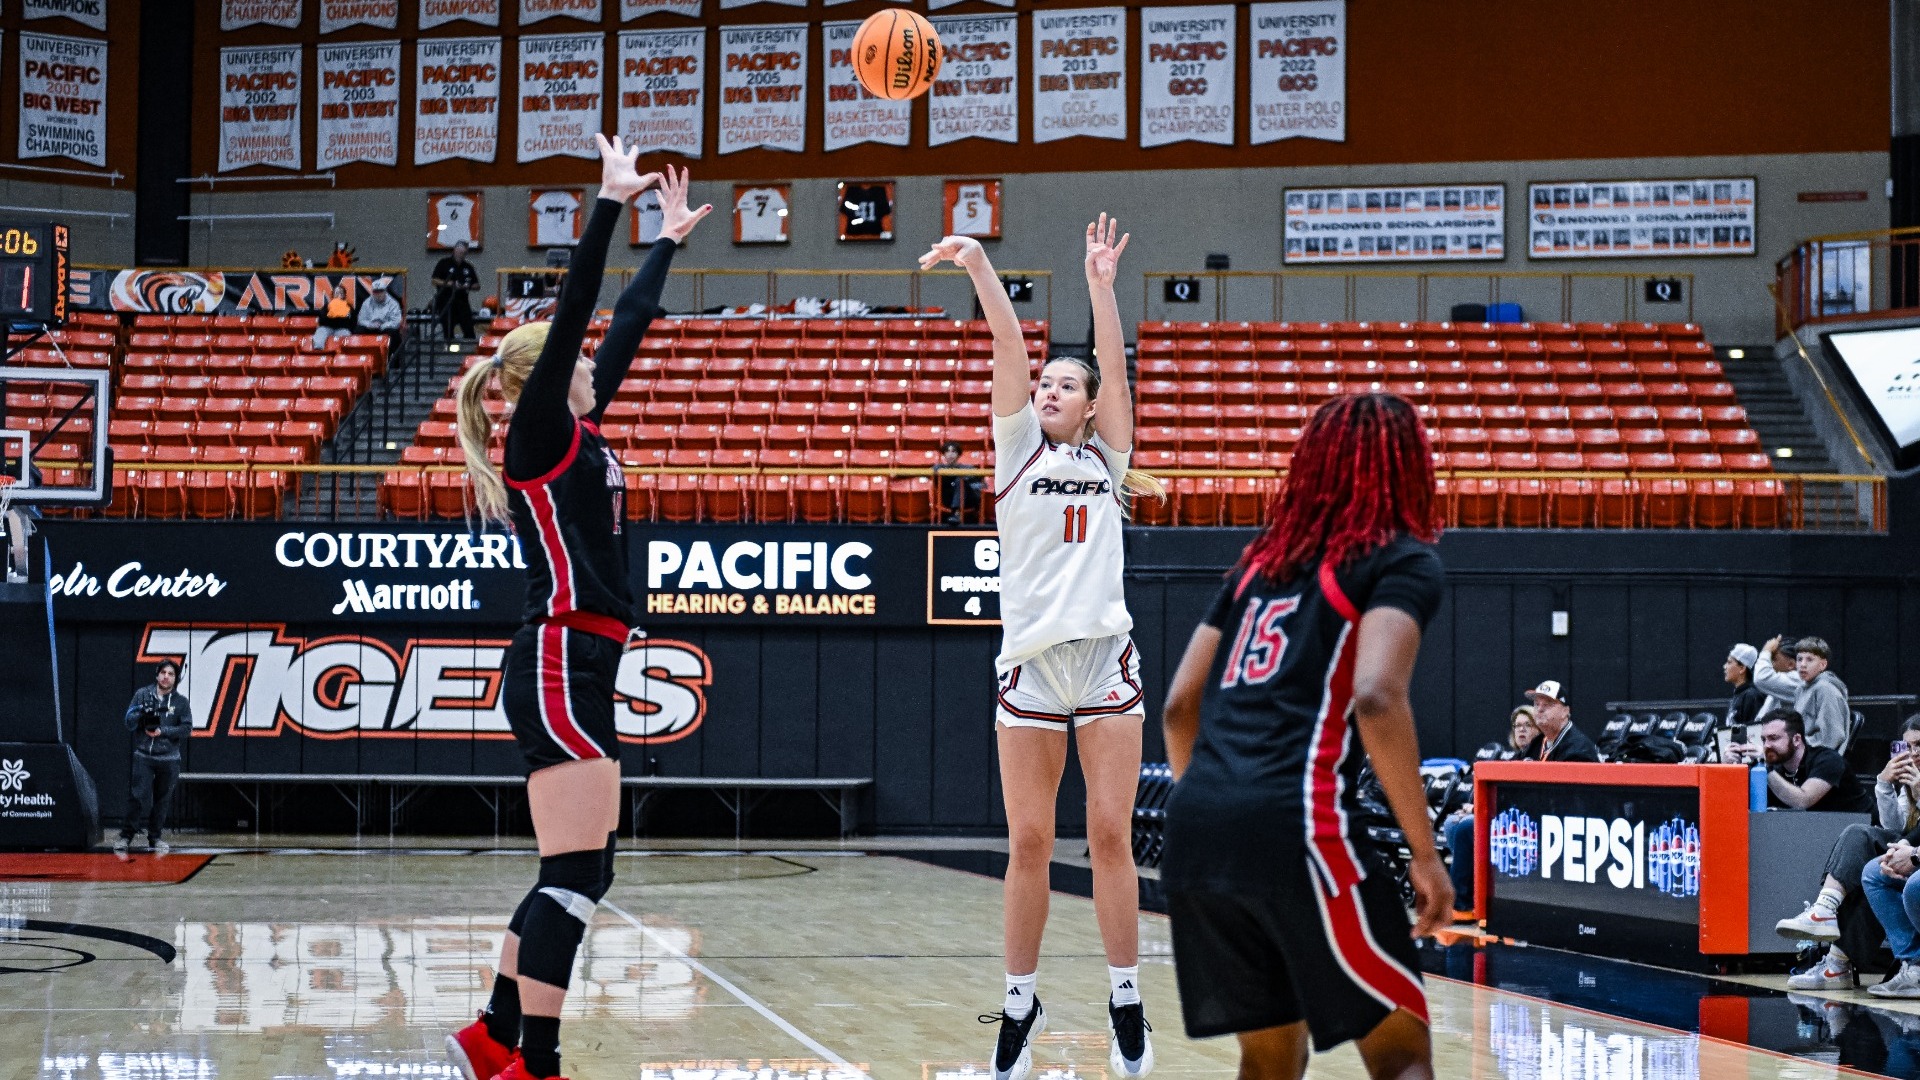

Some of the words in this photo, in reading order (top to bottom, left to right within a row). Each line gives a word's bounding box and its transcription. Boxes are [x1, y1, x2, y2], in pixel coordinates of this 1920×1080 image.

[226, 3, 297, 21] CHAMPIONS
[326, 2, 396, 20] CHAMPIONS
[936, 20, 1010, 35] UNIVERSITY
[1040, 14, 1118, 29] UNIVERSITY
[1149, 18, 1226, 33] UNIVERSITY
[1258, 14, 1337, 29] UNIVERSITY
[625, 34, 698, 50] UNIVERSITY
[726, 30, 799, 44] UNIVERSITY
[27, 38, 100, 56] UNIVERSITY
[323, 47, 393, 61] UNIVERSITY
[424, 43, 495, 57] UNIVERSITY
[525, 40, 597, 54] UNIVERSITY
[1040, 36, 1119, 58] PACIFIC
[1149, 41, 1227, 63] PACIFIC
[1258, 36, 1338, 59] PACIFIC
[227, 50, 295, 65] UNIVERSITY
[624, 55, 698, 77] PACIFIC
[726, 51, 801, 72] PACIFIC
[893, 28, 914, 90] Wilson
[923, 37, 937, 83] NCAA
[1062, 59, 1098, 72] 2013
[1280, 59, 1316, 72] 2022
[24, 59, 101, 85] PACIFIC
[422, 63, 497, 85] PACIFIC
[524, 60, 599, 81] PACIFIC
[1171, 62, 1206, 76] 2017
[226, 71, 297, 93] PACIFIC
[323, 67, 396, 90] PACIFIC
[544, 80, 577, 93] 2004
[645, 76, 678, 90] 2005
[746, 72, 780, 85] 2005
[933, 80, 961, 97] BIG
[965, 76, 1013, 94] WEST
[1039, 74, 1070, 92] BIG
[1072, 72, 1121, 90] WEST
[46, 82, 80, 96] 2003
[244, 91, 277, 104] 2002
[343, 88, 375, 101] 2003
[442, 83, 474, 97] 2004
[724, 86, 752, 104] BIG
[755, 84, 802, 103] WEST
[23, 92, 51, 111] BIG
[54, 96, 101, 116] WEST
[420, 98, 447, 115] BIG
[450, 96, 497, 114] WEST
[522, 96, 551, 112] BIG
[552, 93, 600, 111] WEST
[622, 91, 650, 108] BIG
[652, 89, 700, 106] WEST
[223, 105, 250, 122] BIG
[252, 103, 298, 122] WEST
[321, 103, 349, 119] BIG
[351, 100, 398, 118] WEST
[28, 124, 95, 143] SWIMMING
[26, 138, 98, 157] CHAMPIONS
[325, 145, 393, 160] CHAMPIONS
[422, 140, 493, 155] CHAMPIONS
[524, 138, 597, 152] CHAMPIONS
[226, 148, 294, 163] CHAMPIONS
[757, 202, 767, 217] 7
[967, 202, 978, 219] 5
[1558, 214, 1631, 225] ENDOWED
[1636, 211, 1748, 223] SCHOLARSHIPS
[1312, 220, 1383, 231] ENDOWED
[1386, 218, 1496, 230] SCHOLARSHIPS
[522, 280, 534, 296] P
[1009, 283, 1021, 298] P
[1174, 282, 1190, 300] Q
[1656, 282, 1672, 301] Q
[1063, 505, 1087, 543] 11
[647, 540, 873, 591] PACIFIC
[107, 561, 227, 598] Center
[332, 578, 474, 615] Marriott
[647, 593, 747, 615] HEARING
[752, 593, 770, 615] &
[775, 594, 876, 615] BALANCE
[964, 596, 982, 616] 4
[1220, 592, 1302, 690] 15
[136, 622, 712, 743] TIGES
[1541, 814, 1645, 889] PEPSI
